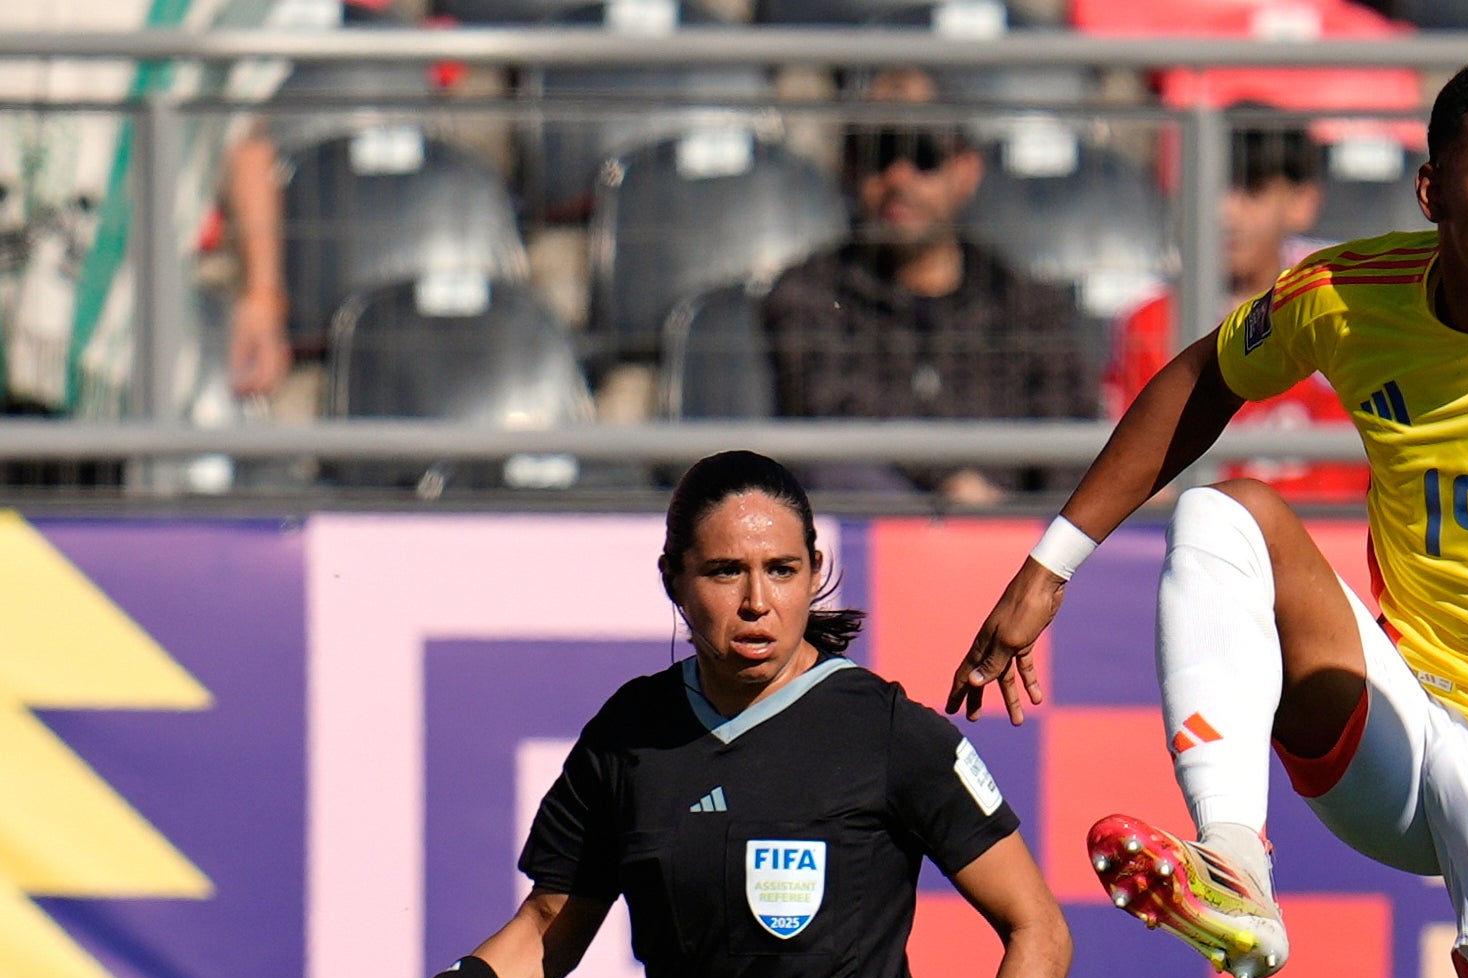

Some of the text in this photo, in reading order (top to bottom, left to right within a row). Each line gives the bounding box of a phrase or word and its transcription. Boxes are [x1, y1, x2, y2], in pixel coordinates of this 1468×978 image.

[754, 848, 817, 870] FIFA
[755, 881, 817, 891] ASSISTANT
[759, 892, 812, 903] REFEREE
[770, 917, 800, 929] 2025
